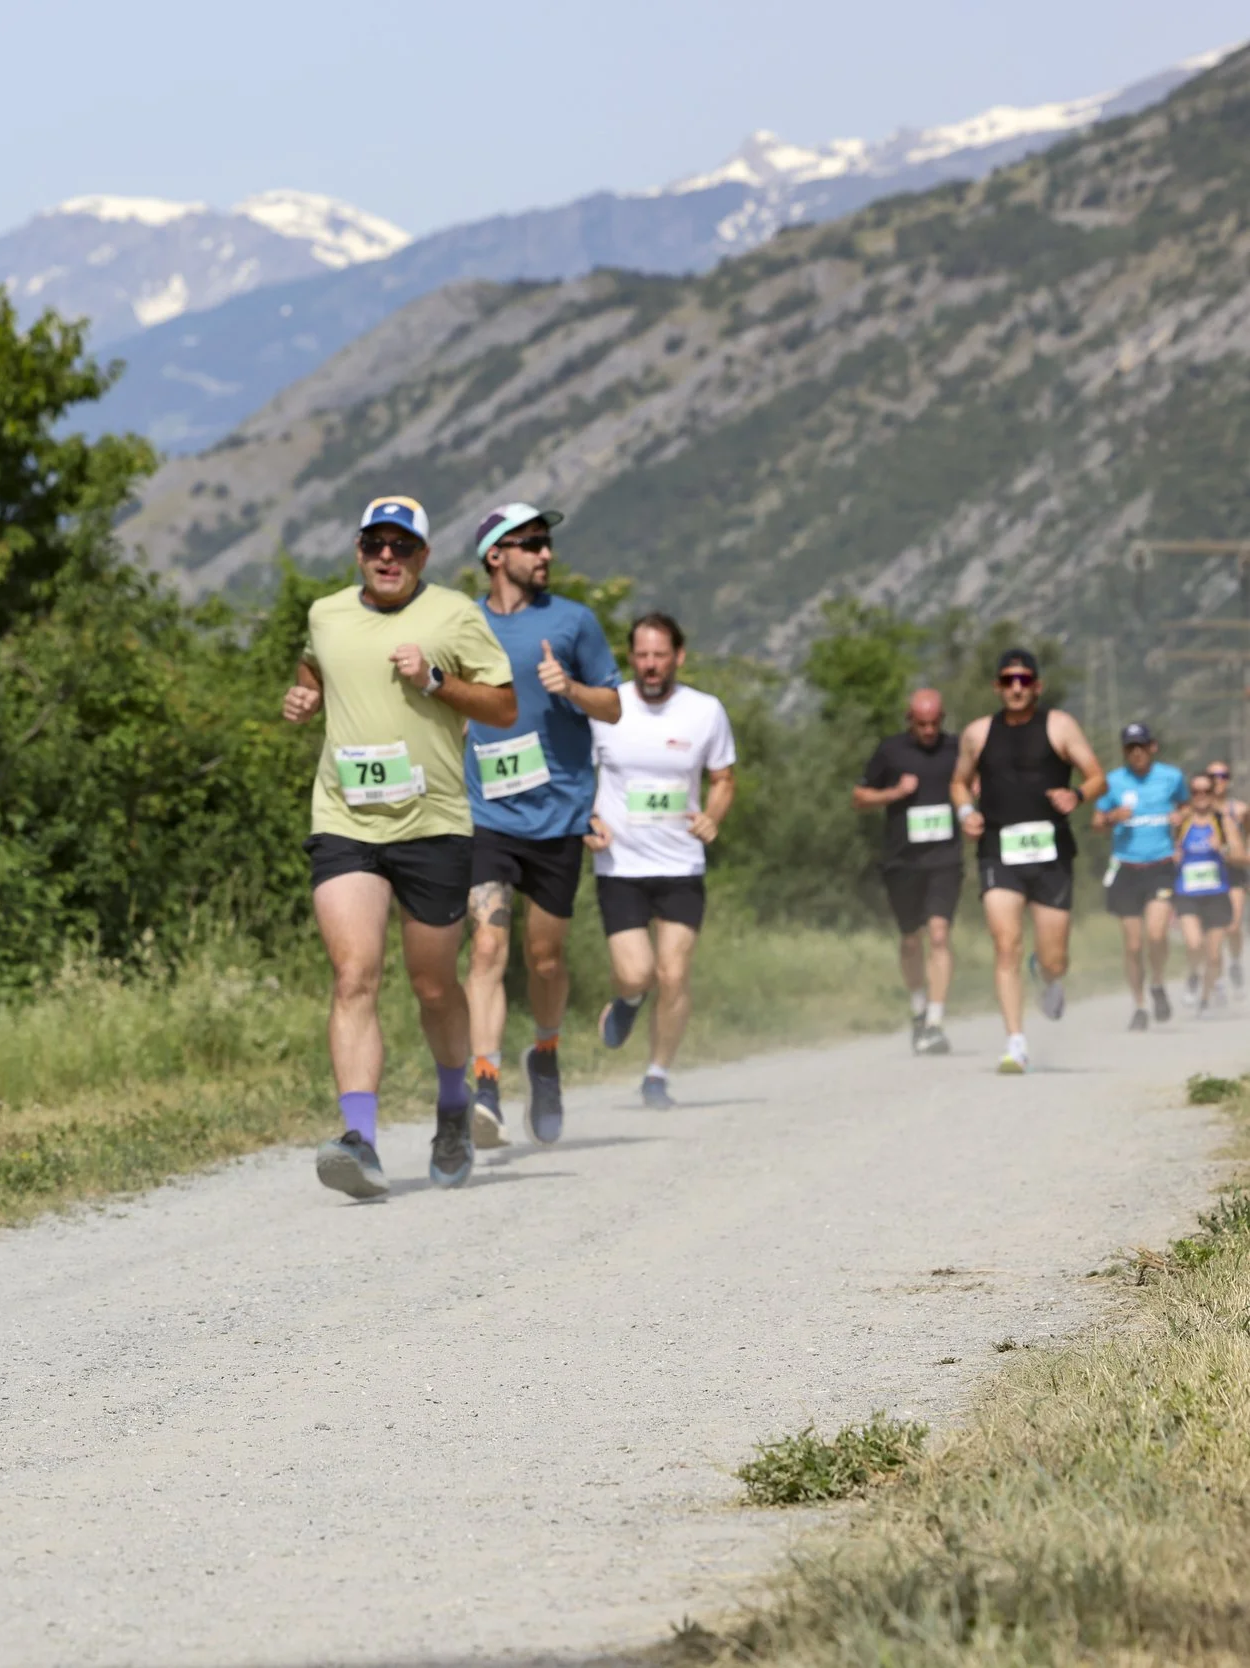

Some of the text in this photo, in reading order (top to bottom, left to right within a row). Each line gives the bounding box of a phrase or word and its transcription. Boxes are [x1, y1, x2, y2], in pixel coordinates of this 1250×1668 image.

[355, 761, 386, 785] 79
[496, 754, 518, 777] 47
[646, 793, 669, 809] 44
